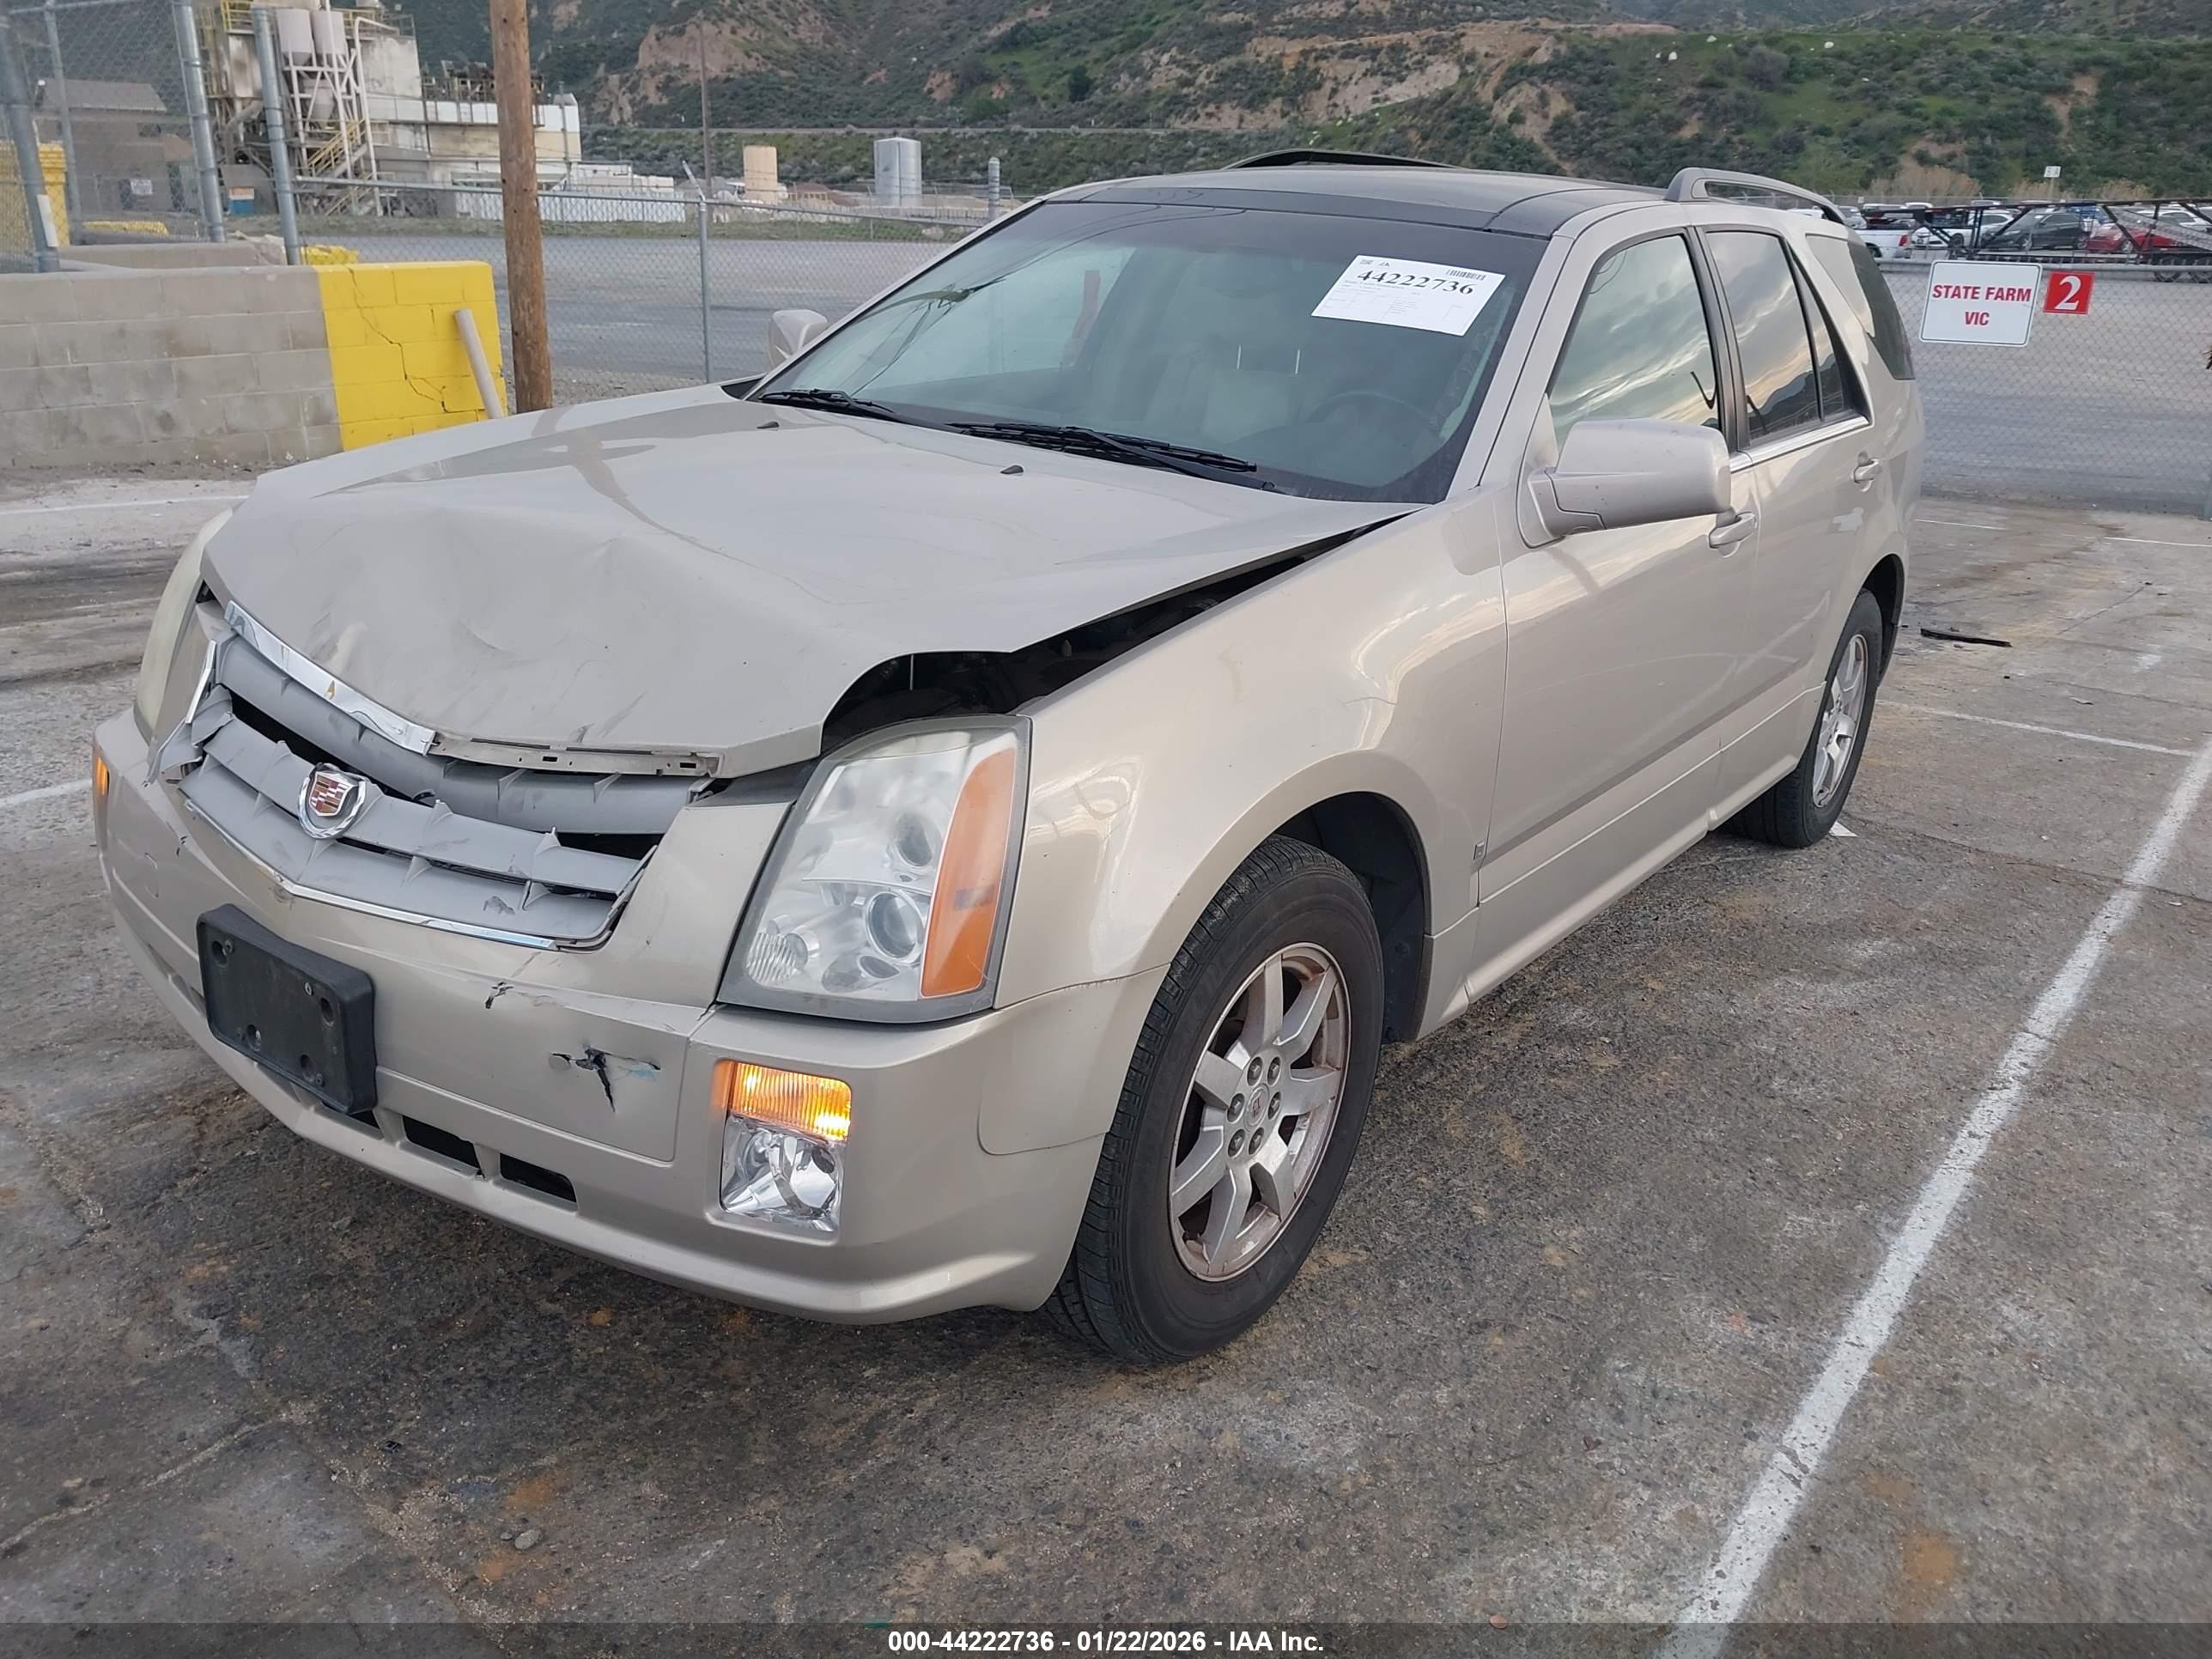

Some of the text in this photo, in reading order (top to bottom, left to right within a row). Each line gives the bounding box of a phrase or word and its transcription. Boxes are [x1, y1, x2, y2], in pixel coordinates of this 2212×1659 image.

[1357, 270, 1477, 295] 44222736
[1932, 284, 2032, 302] STATE FARM
[2054, 275, 2082, 311] 2
[1965, 311, 1990, 325] VIC
